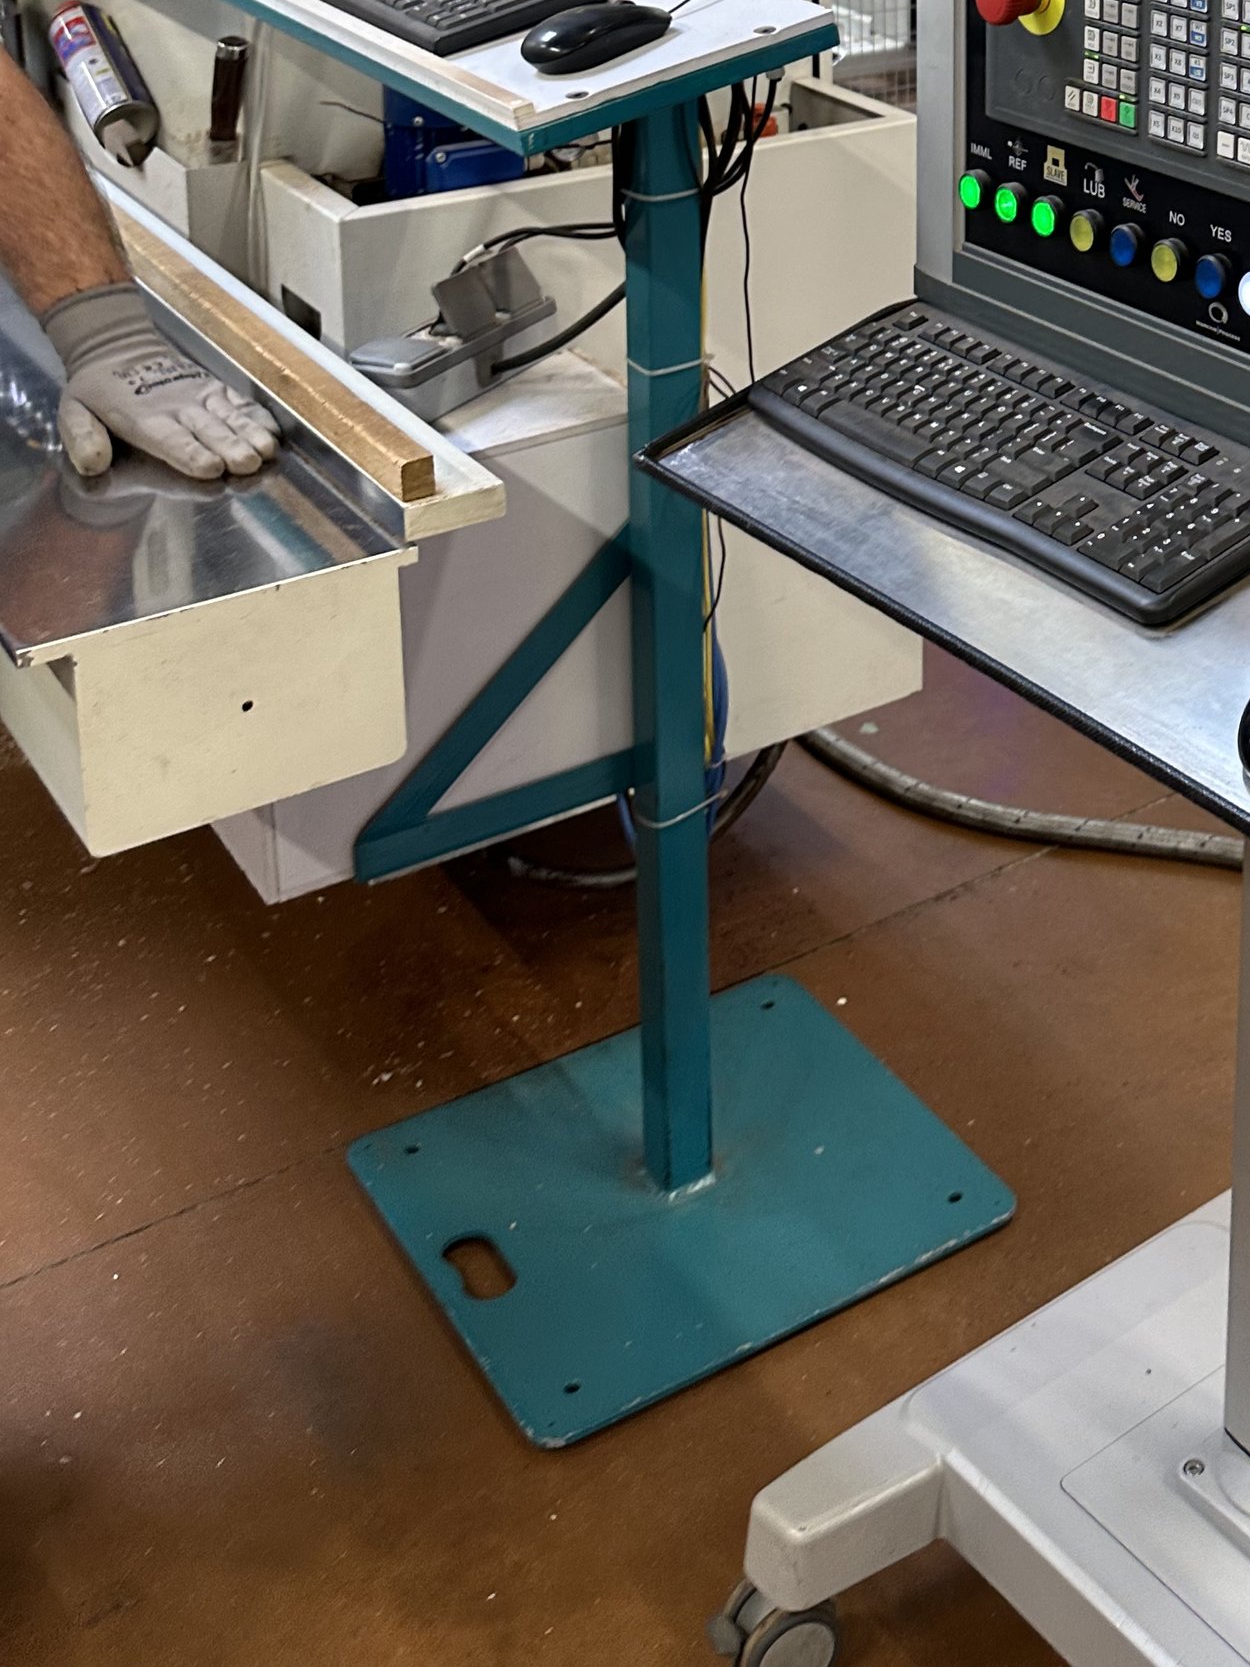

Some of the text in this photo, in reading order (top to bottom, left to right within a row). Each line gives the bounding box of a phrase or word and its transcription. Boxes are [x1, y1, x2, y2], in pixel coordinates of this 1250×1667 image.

[970, 142, 992, 160] IMML
[1008, 156, 1027, 171] REF
[1046, 166, 1065, 181] SLAVE
[1083, 178, 1106, 198] LUB
[1122, 197, 1147, 214] SERVICE
[1169, 210, 1185, 226] NO
[1210, 224, 1232, 242] YES
